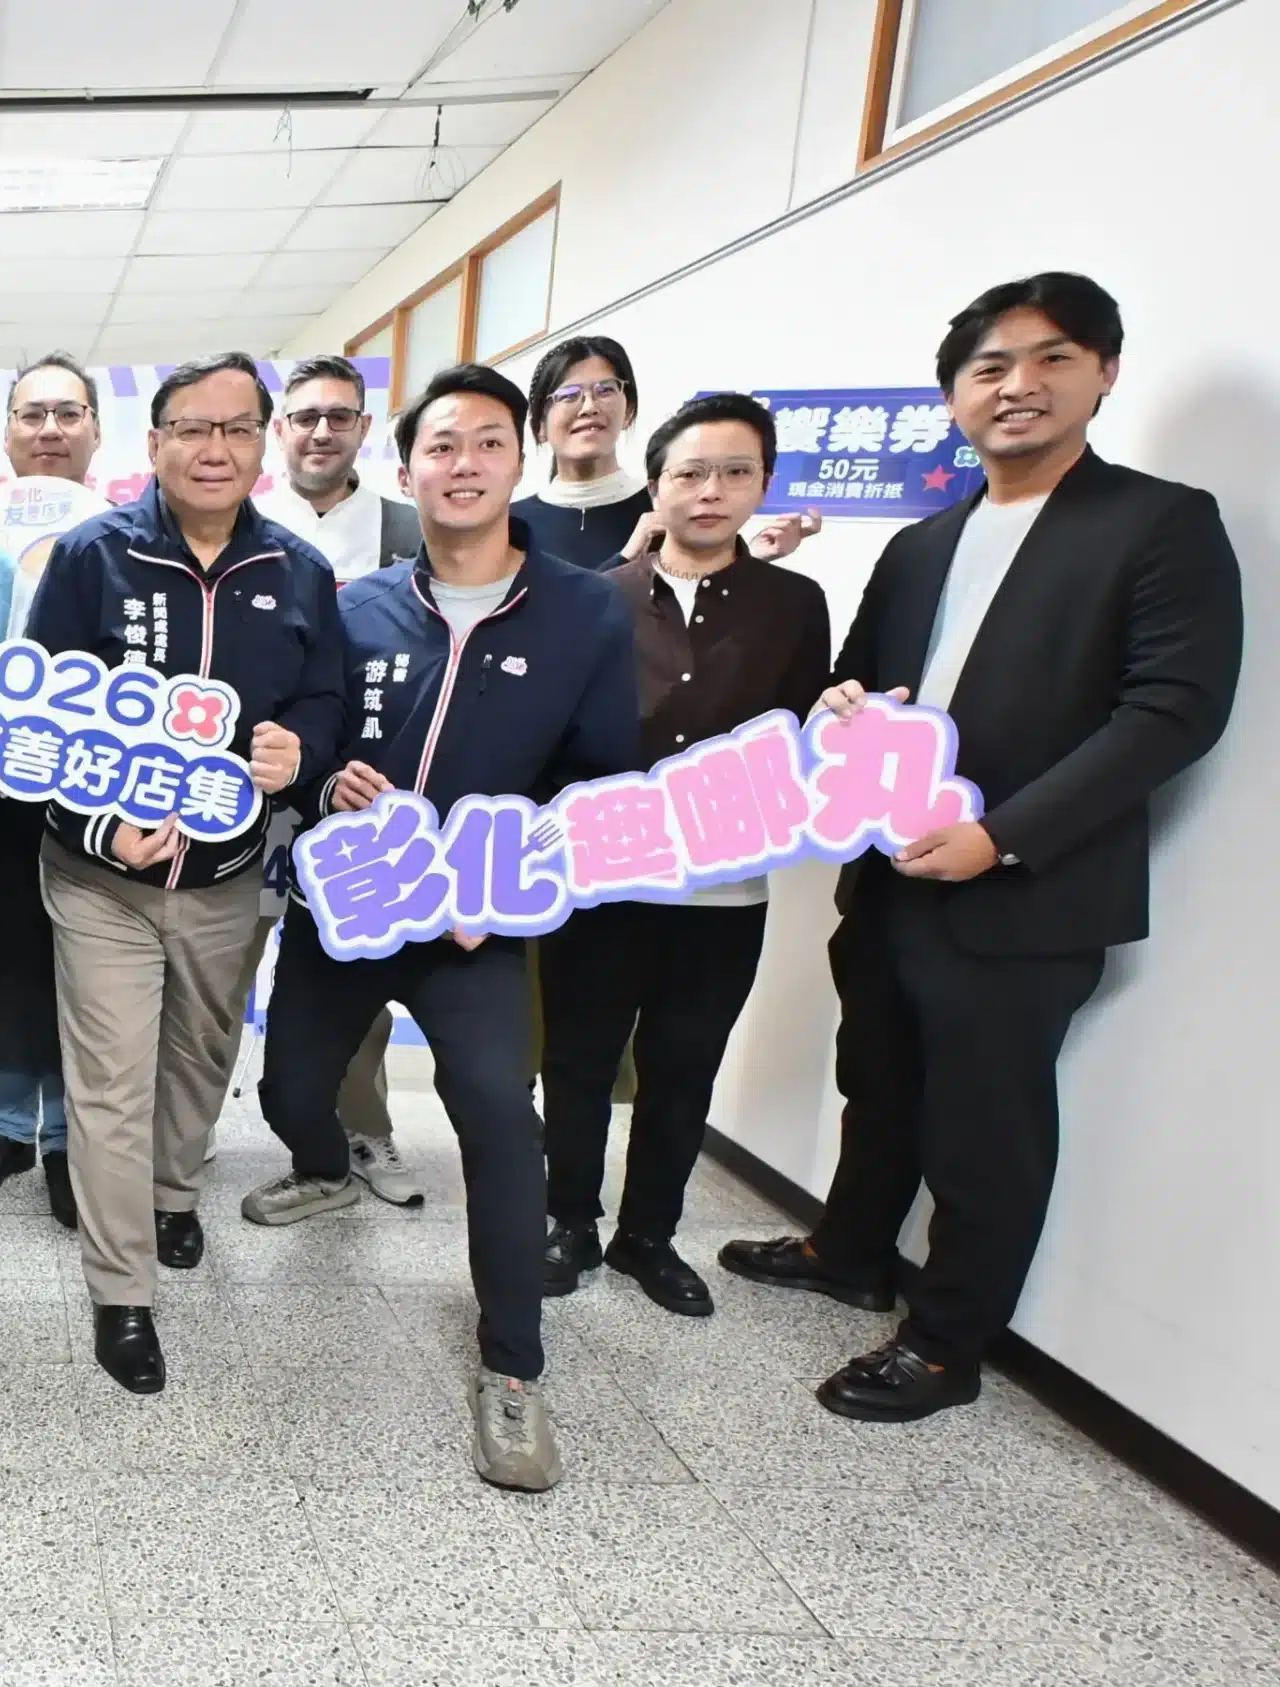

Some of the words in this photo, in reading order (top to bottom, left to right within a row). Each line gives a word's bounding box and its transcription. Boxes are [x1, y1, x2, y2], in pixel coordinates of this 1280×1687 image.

[775, 404, 952, 453] 饗樂券
[818, 458, 880, 481] 50元
[788, 482, 904, 500] 現金消費折抵
